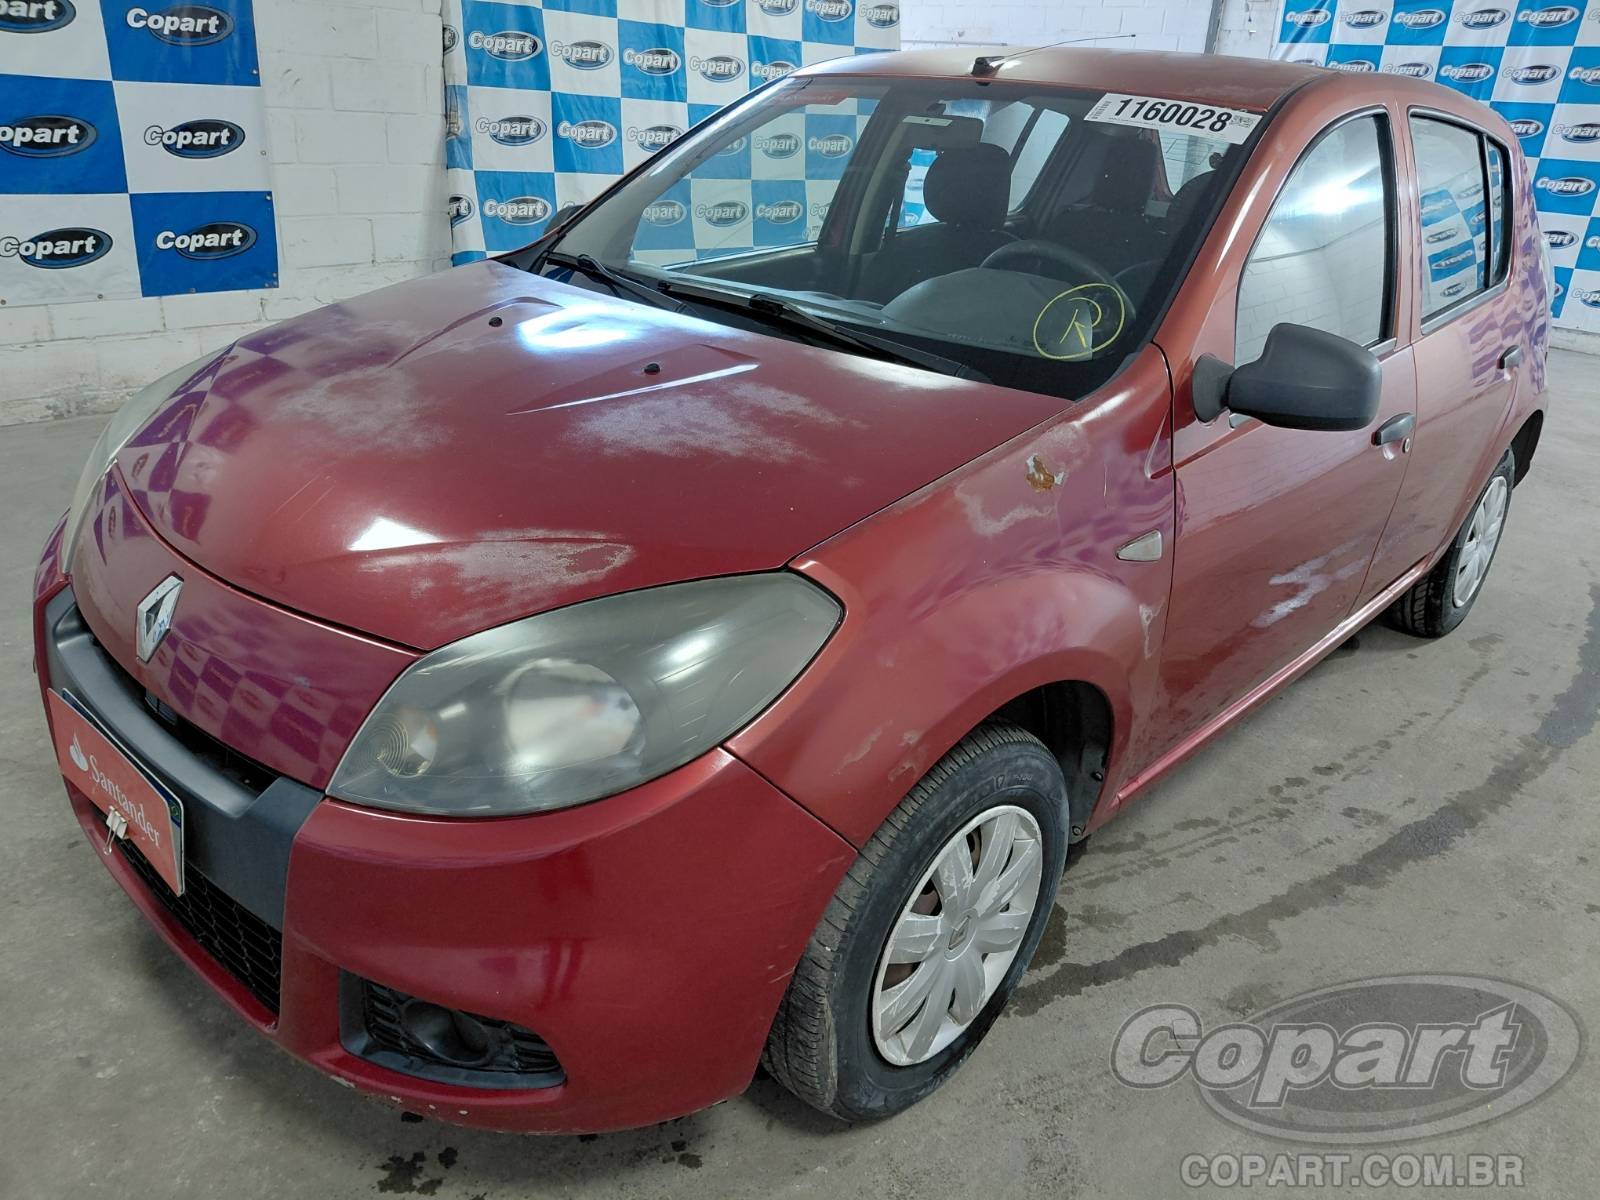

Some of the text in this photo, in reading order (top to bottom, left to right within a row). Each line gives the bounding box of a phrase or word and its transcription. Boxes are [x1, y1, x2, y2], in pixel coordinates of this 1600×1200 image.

[127, 7, 219, 34] Copart
[859, 5, 898, 21] Copart
[1286, 11, 1325, 24] Copart
[1394, 11, 1440, 25] Copart
[1455, 11, 1501, 25] Copart
[1518, 9, 1570, 23] Copart
[470, 32, 533, 54] Copart
[551, 42, 608, 61] Copart
[624, 51, 675, 68] Copart
[689, 57, 737, 76] Copart
[752, 62, 787, 80] Copa
[1440, 65, 1488, 79] Copart
[1504, 66, 1552, 80] Copart
[1114, 98, 1232, 132] 1160028
[0, 124, 79, 146] opart
[144, 126, 230, 148] Copart
[476, 119, 537, 139] Copart
[559, 121, 609, 140] Copart
[628, 128, 677, 146] Copart
[755, 138, 797, 152] Copart
[808, 138, 848, 153] Copart
[1537, 177, 1588, 192] Copart
[485, 200, 543, 219] Copart
[643, 204, 681, 223] opart
[696, 205, 742, 222] Copart
[757, 205, 798, 220] Copart
[0, 236, 96, 260] Copart
[156, 230, 242, 251] Copart
[89, 755, 160, 847] Santander
